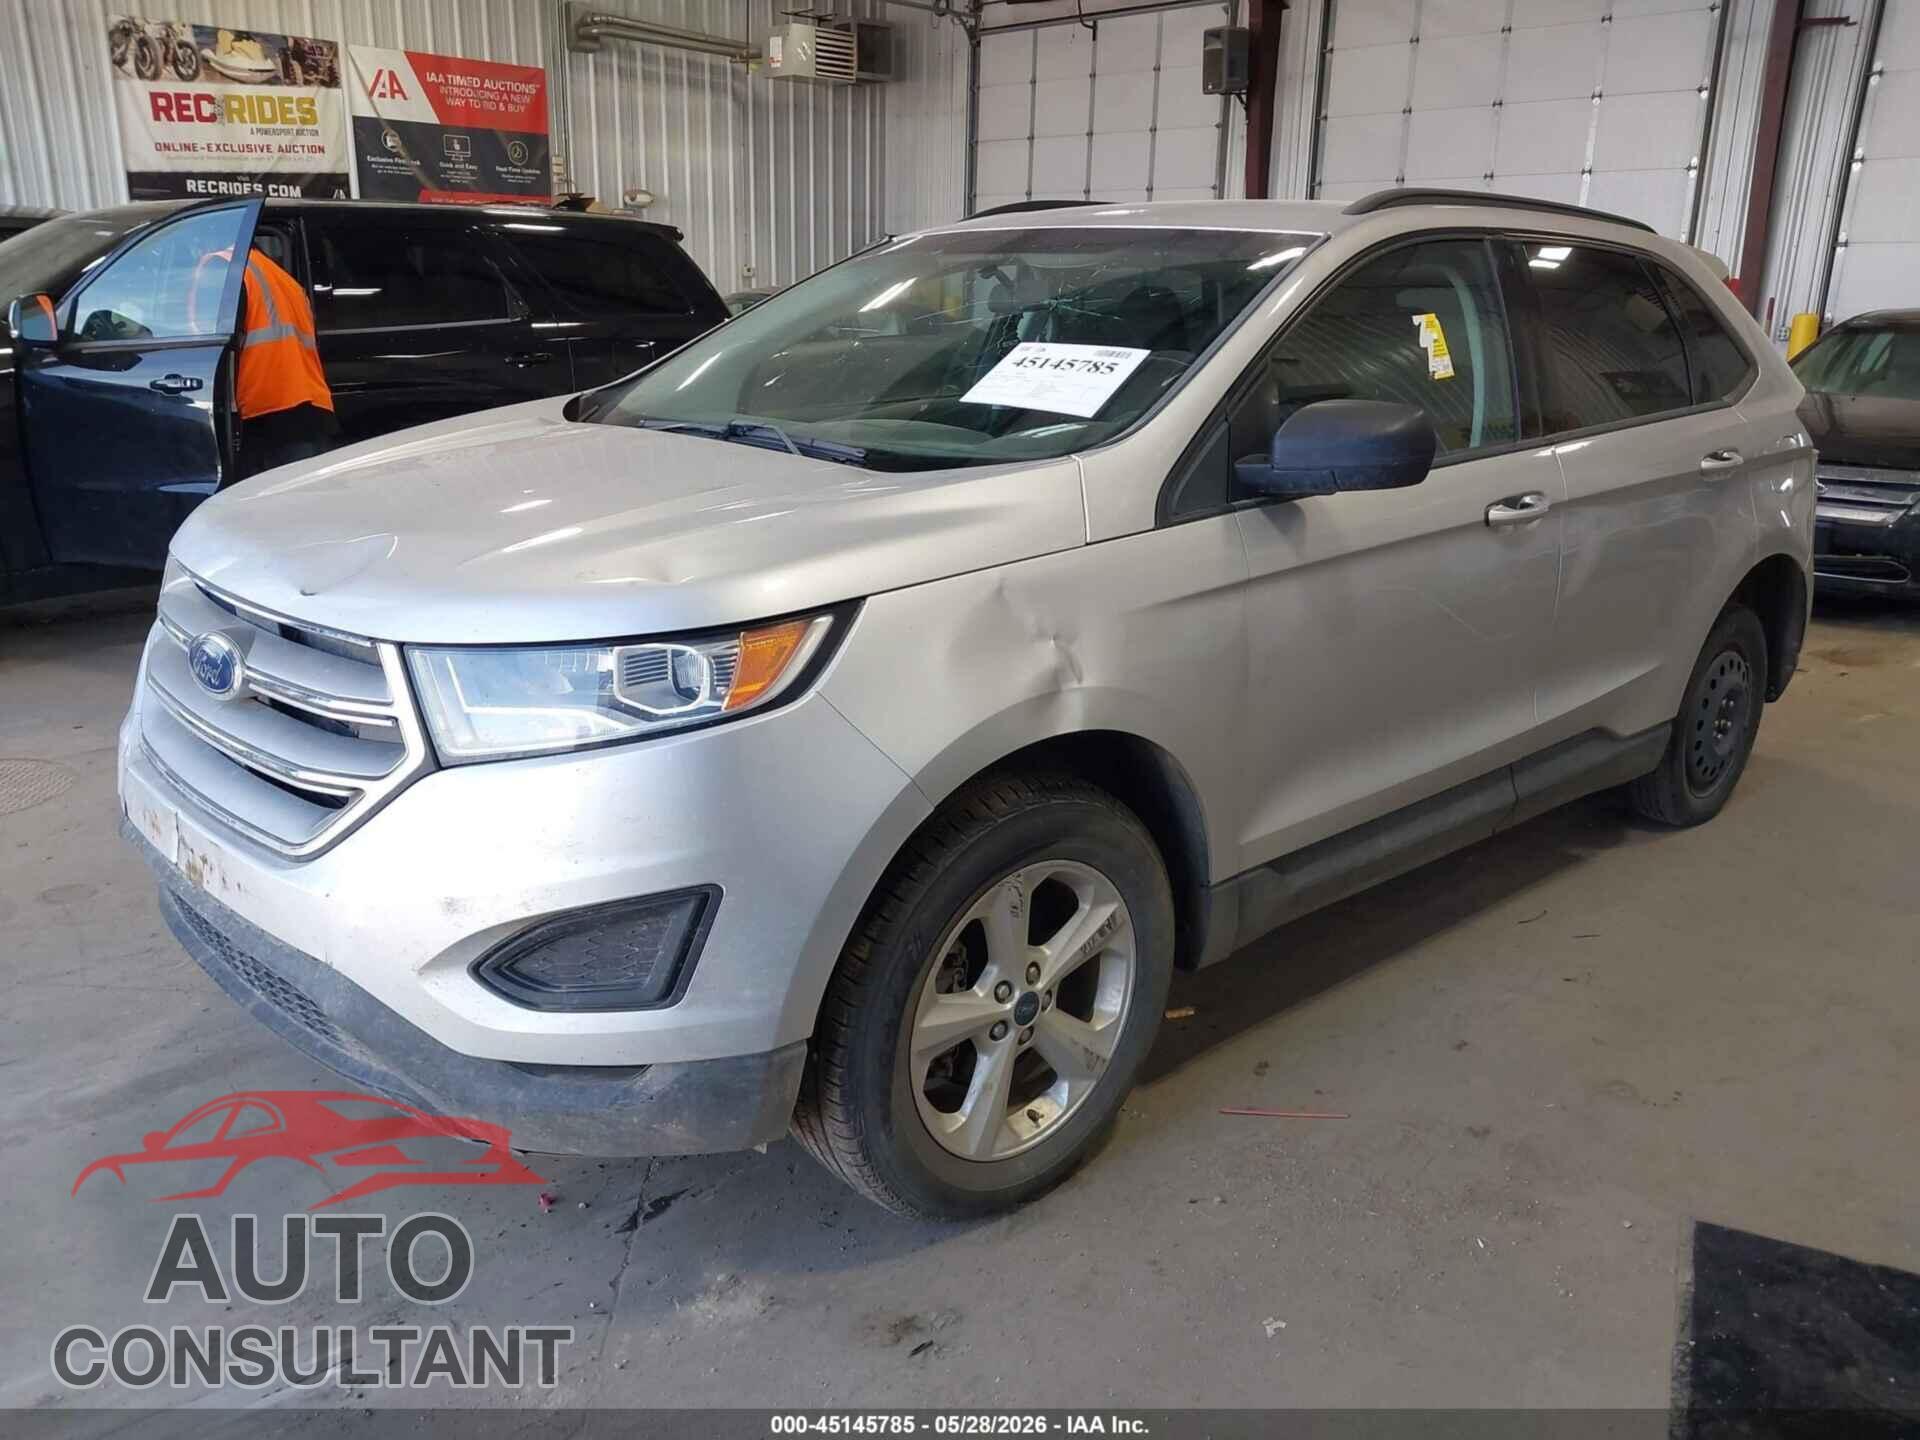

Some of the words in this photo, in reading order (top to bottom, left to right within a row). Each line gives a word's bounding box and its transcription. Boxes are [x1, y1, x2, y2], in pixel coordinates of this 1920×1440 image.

[426, 72, 445, 84] IAA
[447, 74, 480, 88] TIMED
[439, 86, 500, 100] INTRODUCING
[501, 93, 510, 102] A
[510, 94, 530, 104] NEW
[446, 97, 465, 107] WAY
[470, 99, 481, 109] TO
[499, 103, 506, 112] &
[508, 103, 526, 113] BUY
[296, 128, 319, 136] AUCTION
[154, 142, 273, 154] ONLINE-EXCLUSIVE
[277, 144, 326, 154] AUCTION
[186, 179, 302, 198] RECRIDESCOM
[1011, 356, 1121, 375] 45145785
